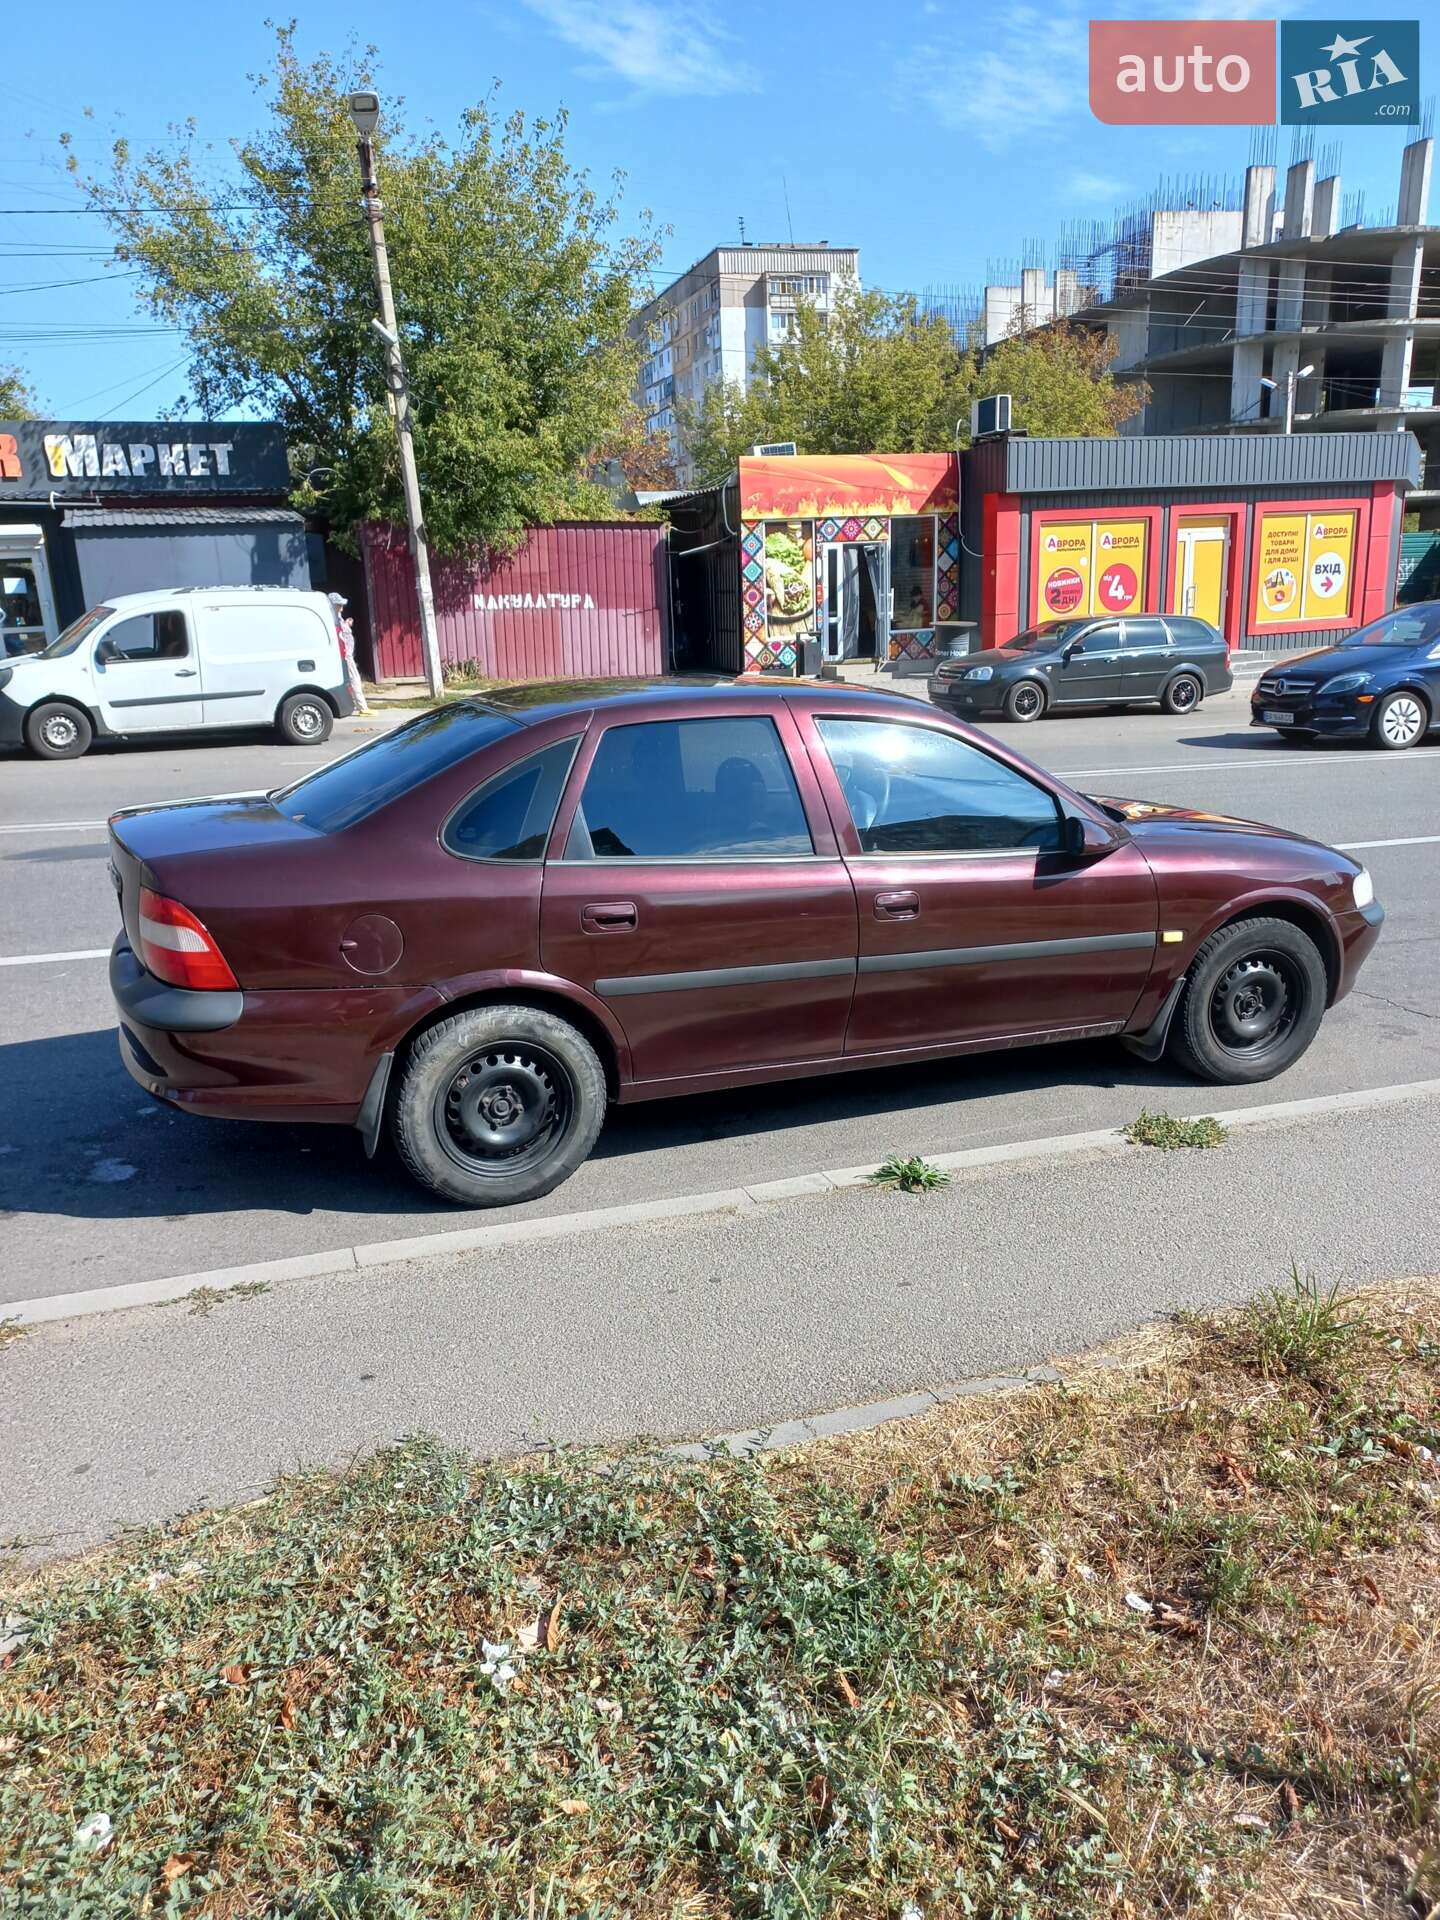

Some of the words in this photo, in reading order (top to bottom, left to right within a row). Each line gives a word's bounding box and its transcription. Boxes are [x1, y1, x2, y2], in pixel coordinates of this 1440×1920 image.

[1314, 563, 1341, 575] ВХІД
[1108, 575, 1125, 600] 4
[1050, 588, 1061, 604] 2
